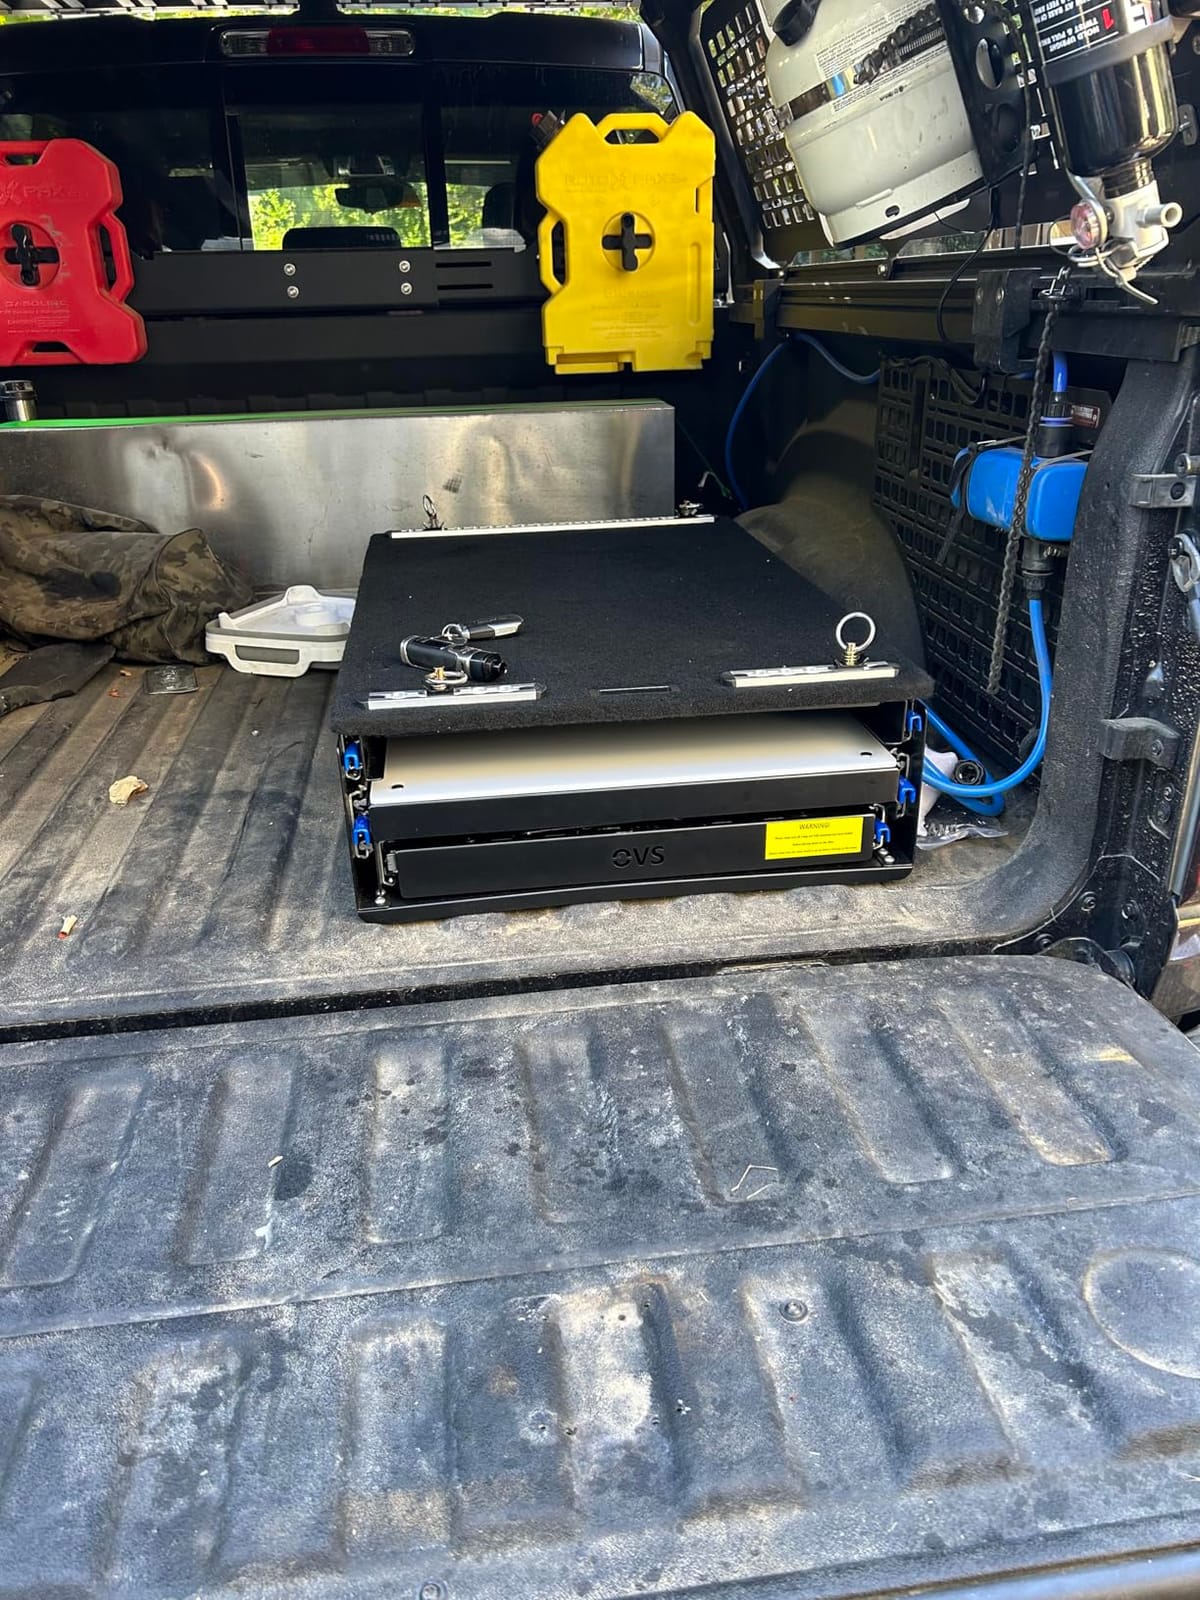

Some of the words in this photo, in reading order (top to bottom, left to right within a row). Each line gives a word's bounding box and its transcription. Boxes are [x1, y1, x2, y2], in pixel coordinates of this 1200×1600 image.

[1102, 8, 1115, 30] 1
[1077, 25, 1100, 40] HOLD
[612, 845, 665, 867] OVS
